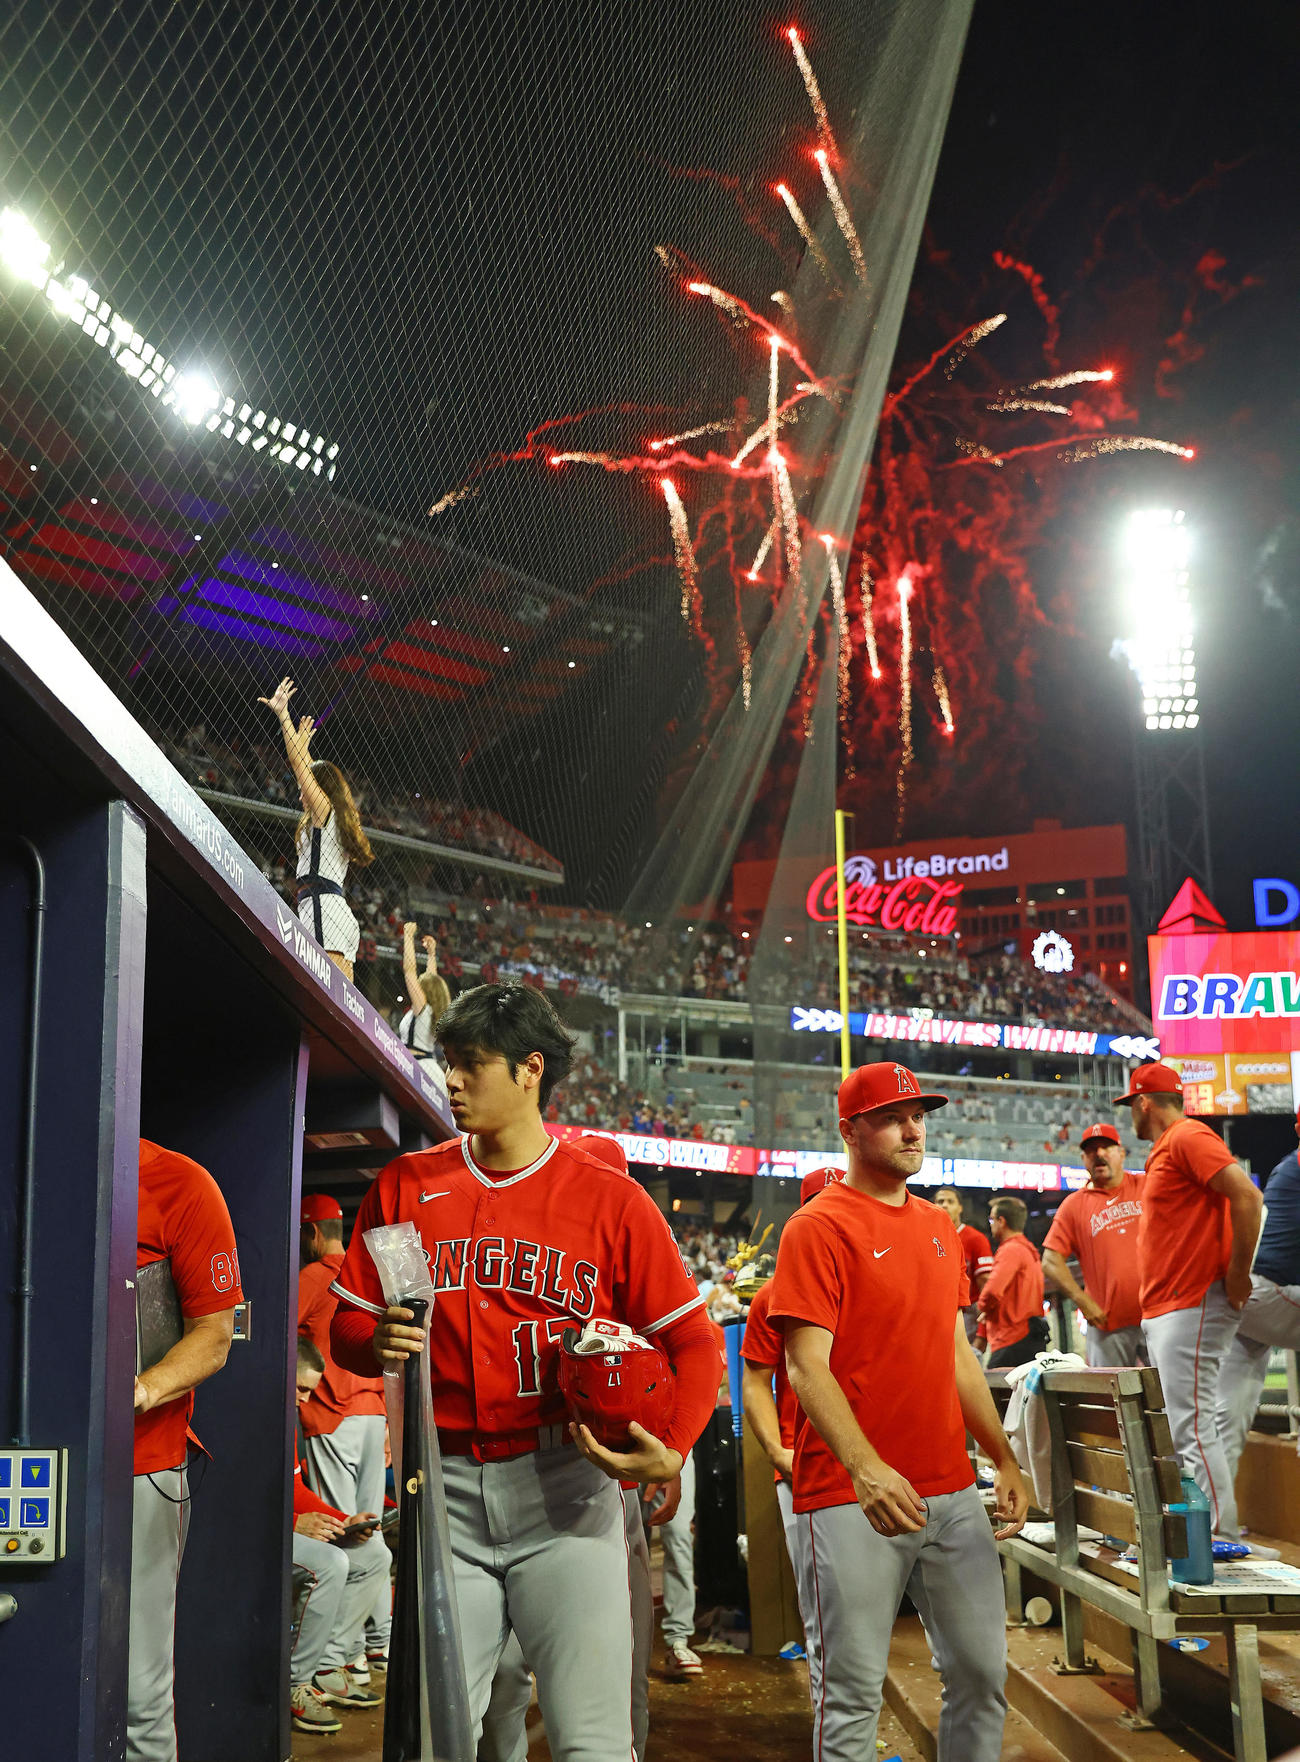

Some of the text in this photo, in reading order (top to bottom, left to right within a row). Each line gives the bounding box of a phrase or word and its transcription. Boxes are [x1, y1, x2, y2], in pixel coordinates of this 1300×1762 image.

[166, 769, 245, 890] YanmarUS.com
[883, 847, 1009, 881] LifeBrand
[293, 925, 331, 990] YANMAR
[342, 982, 366, 1024] Tractors
[417, 1231, 598, 1320] NGELS
